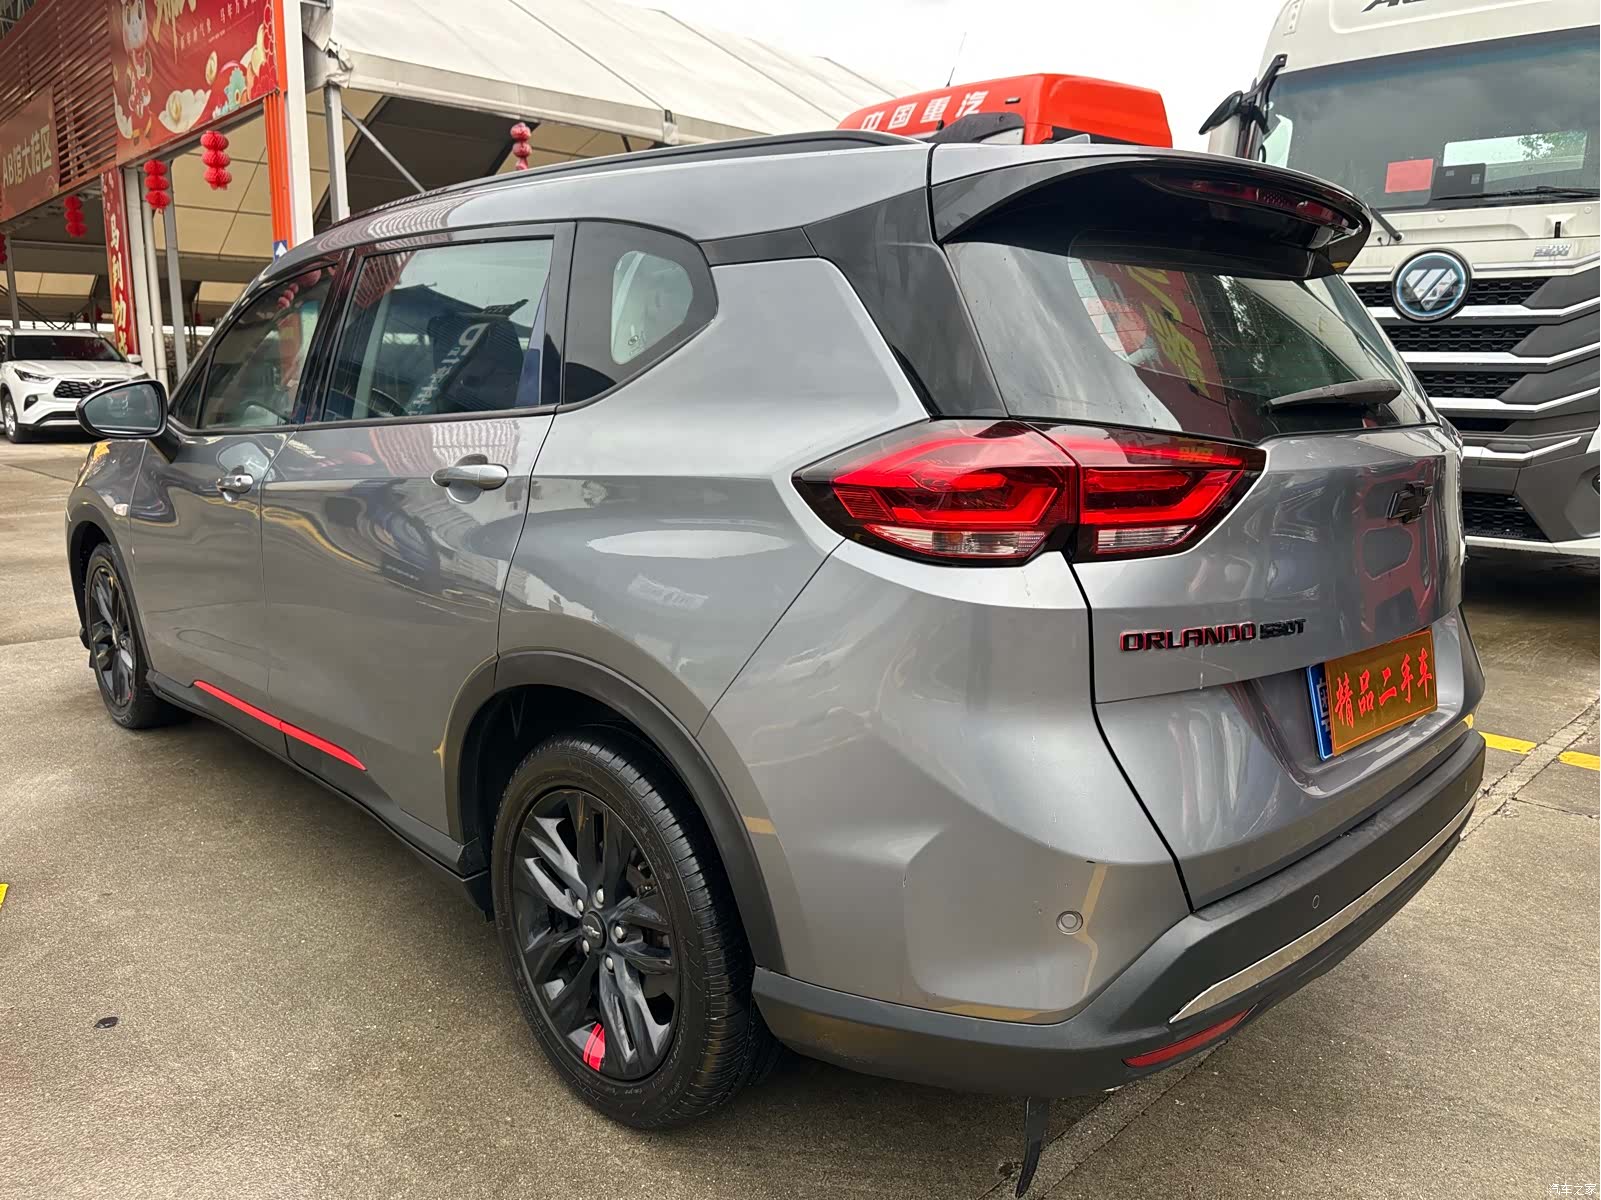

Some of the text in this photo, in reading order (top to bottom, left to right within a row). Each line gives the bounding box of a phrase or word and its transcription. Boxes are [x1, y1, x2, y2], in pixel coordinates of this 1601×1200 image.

[860, 91, 990, 131] 中国重汽
[1120, 621, 1257, 651] ORLANDO
[1335, 647, 1433, 728] 精品二手车
